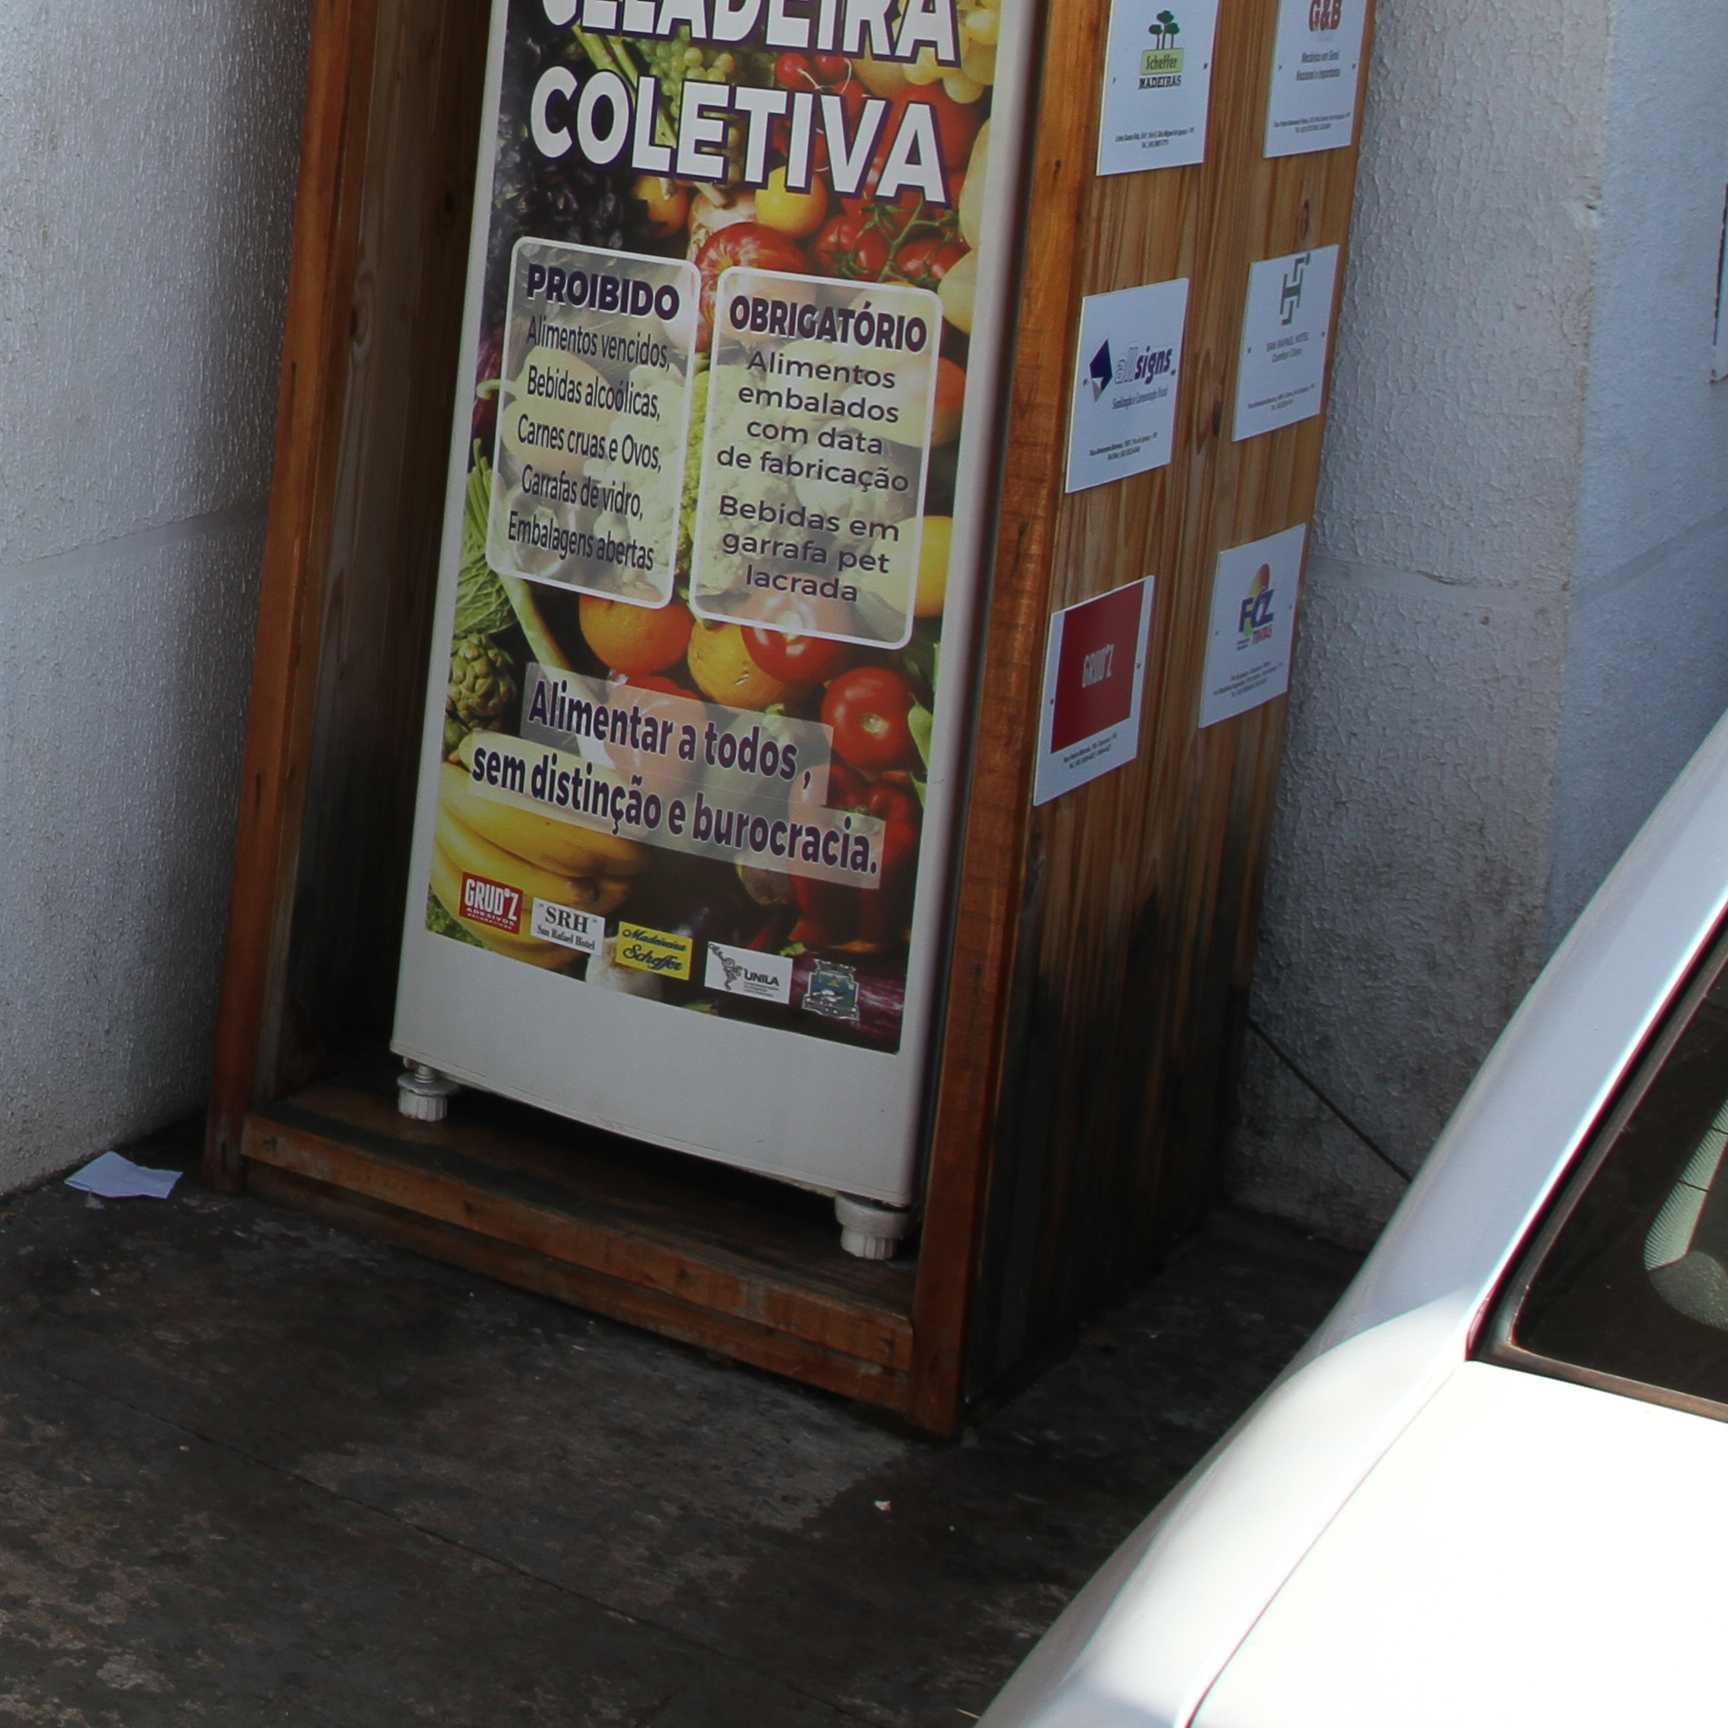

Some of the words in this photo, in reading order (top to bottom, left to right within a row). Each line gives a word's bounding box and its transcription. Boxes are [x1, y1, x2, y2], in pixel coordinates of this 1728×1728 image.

[1138, 74, 1182, 90] MADEIRAS
[1145, 53, 1178, 71] Scheffer
[530, 65, 946, 203] COLETIVA
[527, 264, 681, 321] PROIBIDO
[527, 315, 598, 359] Alimentos
[600, 332, 671, 372] vencidos,
[729, 294, 928, 353] OBRIGATÓRIO
[527, 366, 582, 406] Bebidas
[584, 373, 662, 422] alcoólicas,
[747, 351, 896, 390] Alimentos
[737, 383, 900, 424] embalados
[517, 414, 565, 451] Carnes
[567, 427, 605, 460] cruas
[608, 440, 618, 461] e
[621, 438, 662, 473] Ovos,
[746, 419, 809, 446] com
[817, 426, 883, 456] data
[521, 465, 578, 504] Garrafas
[579, 477, 599, 508] de
[600, 477, 645, 520] vidro,
[716, 445, 752, 470] de
[760, 450, 910, 493] fabricação
[508, 511, 593, 560] Embalagens
[594, 535, 654, 572] abertas
[718, 494, 840, 534] Bebidas
[849, 518, 900, 543] em
[721, 530, 827, 568] garrafa
[838, 548, 891, 584] pet
[745, 564, 859, 603] lacrada
[528, 677, 672, 757] Alimentar
[678, 727, 696, 762] a
[471, 743, 526, 793] sem
[530, 750, 662, 835] distinção
[667, 803, 687, 834] e
[692, 791, 879, 876] burocracia.
[545, 905, 589, 934] SRH
[744, 968, 780, 987] UNILA
